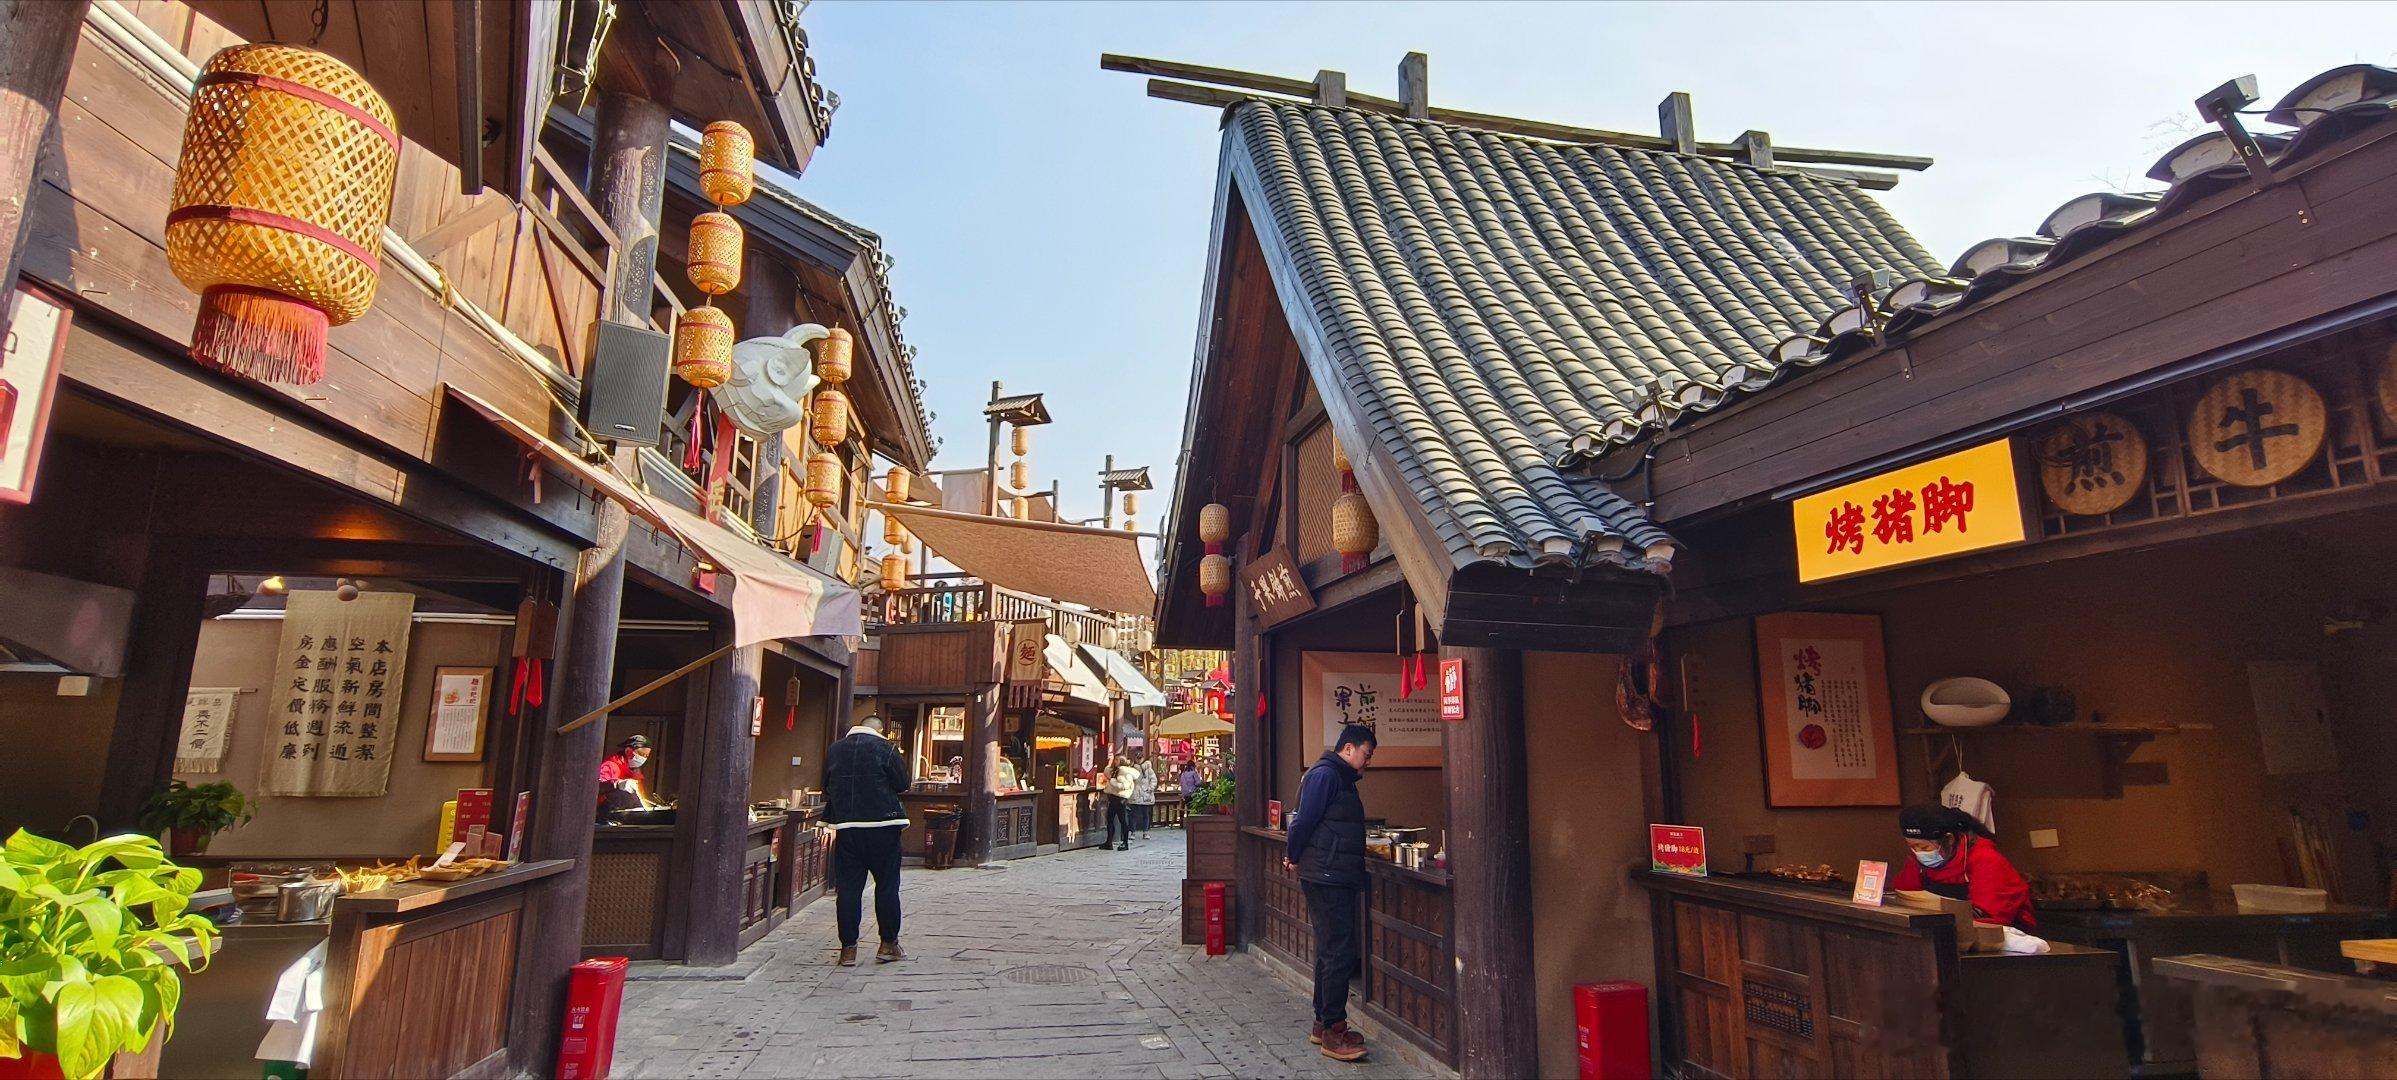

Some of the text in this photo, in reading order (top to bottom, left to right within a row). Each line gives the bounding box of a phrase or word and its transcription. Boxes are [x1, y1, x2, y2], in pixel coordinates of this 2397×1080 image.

[2214, 387, 2300, 471] 牛
[1825, 475, 1975, 556] 烤猪脚
[278, 634, 314, 760] 房金定價低廉
[354, 639, 394, 762] 本店房間整潔
